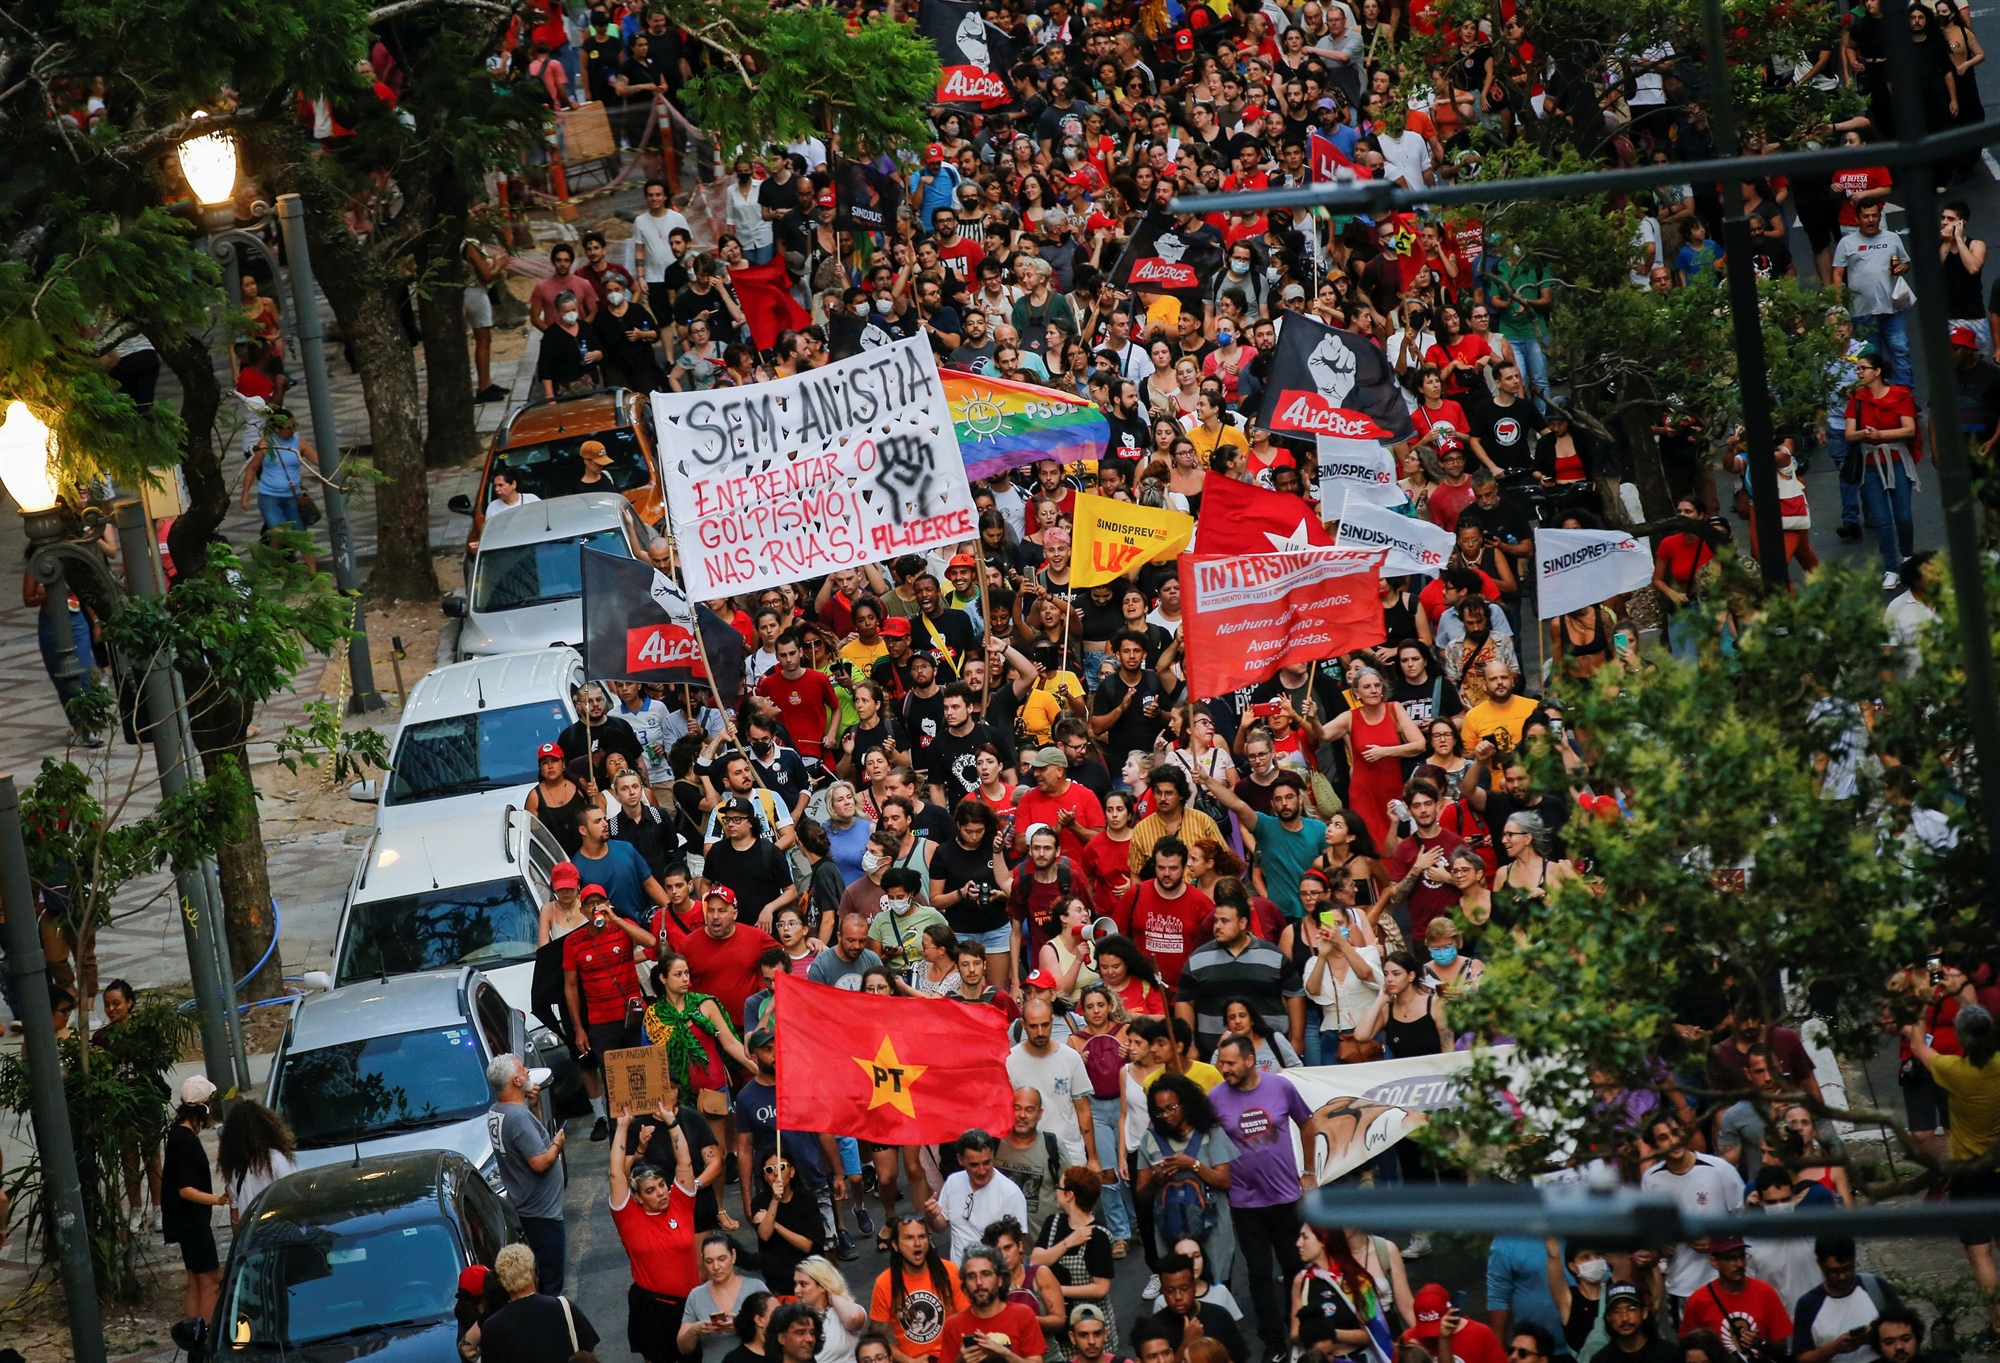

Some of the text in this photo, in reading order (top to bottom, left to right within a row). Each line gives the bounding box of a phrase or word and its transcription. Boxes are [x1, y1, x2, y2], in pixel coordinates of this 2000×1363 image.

[851, 206, 882, 223] SINDJUS
[1395, 232, 1410, 251] PT
[1024, 400, 1078, 419] PSOL
[686, 394, 778, 465] SEM
[692, 439, 878, 517] ENFRENTAR O
[1377, 471, 1391, 483] RS
[699, 491, 844, 549] GOLPISMO
[1097, 519, 1155, 537] SINDISPREV
[1124, 536, 1135, 545] NA
[1421, 549, 1442, 565] RS
[703, 548, 756, 588] NAS
[1253, 591, 1268, 599] LUTA
[1216, 619, 1272, 636] Nenhum
[1309, 594, 1351, 610] menos.
[609, 1051, 623, 1060] SEM
[872, 1065, 904, 1093] PT
[1242, 1110, 1264, 1118] COLETIVO
[1240, 1119, 1268, 1128] RESISTIR
[914, 1293, 943, 1312] RACISTS
